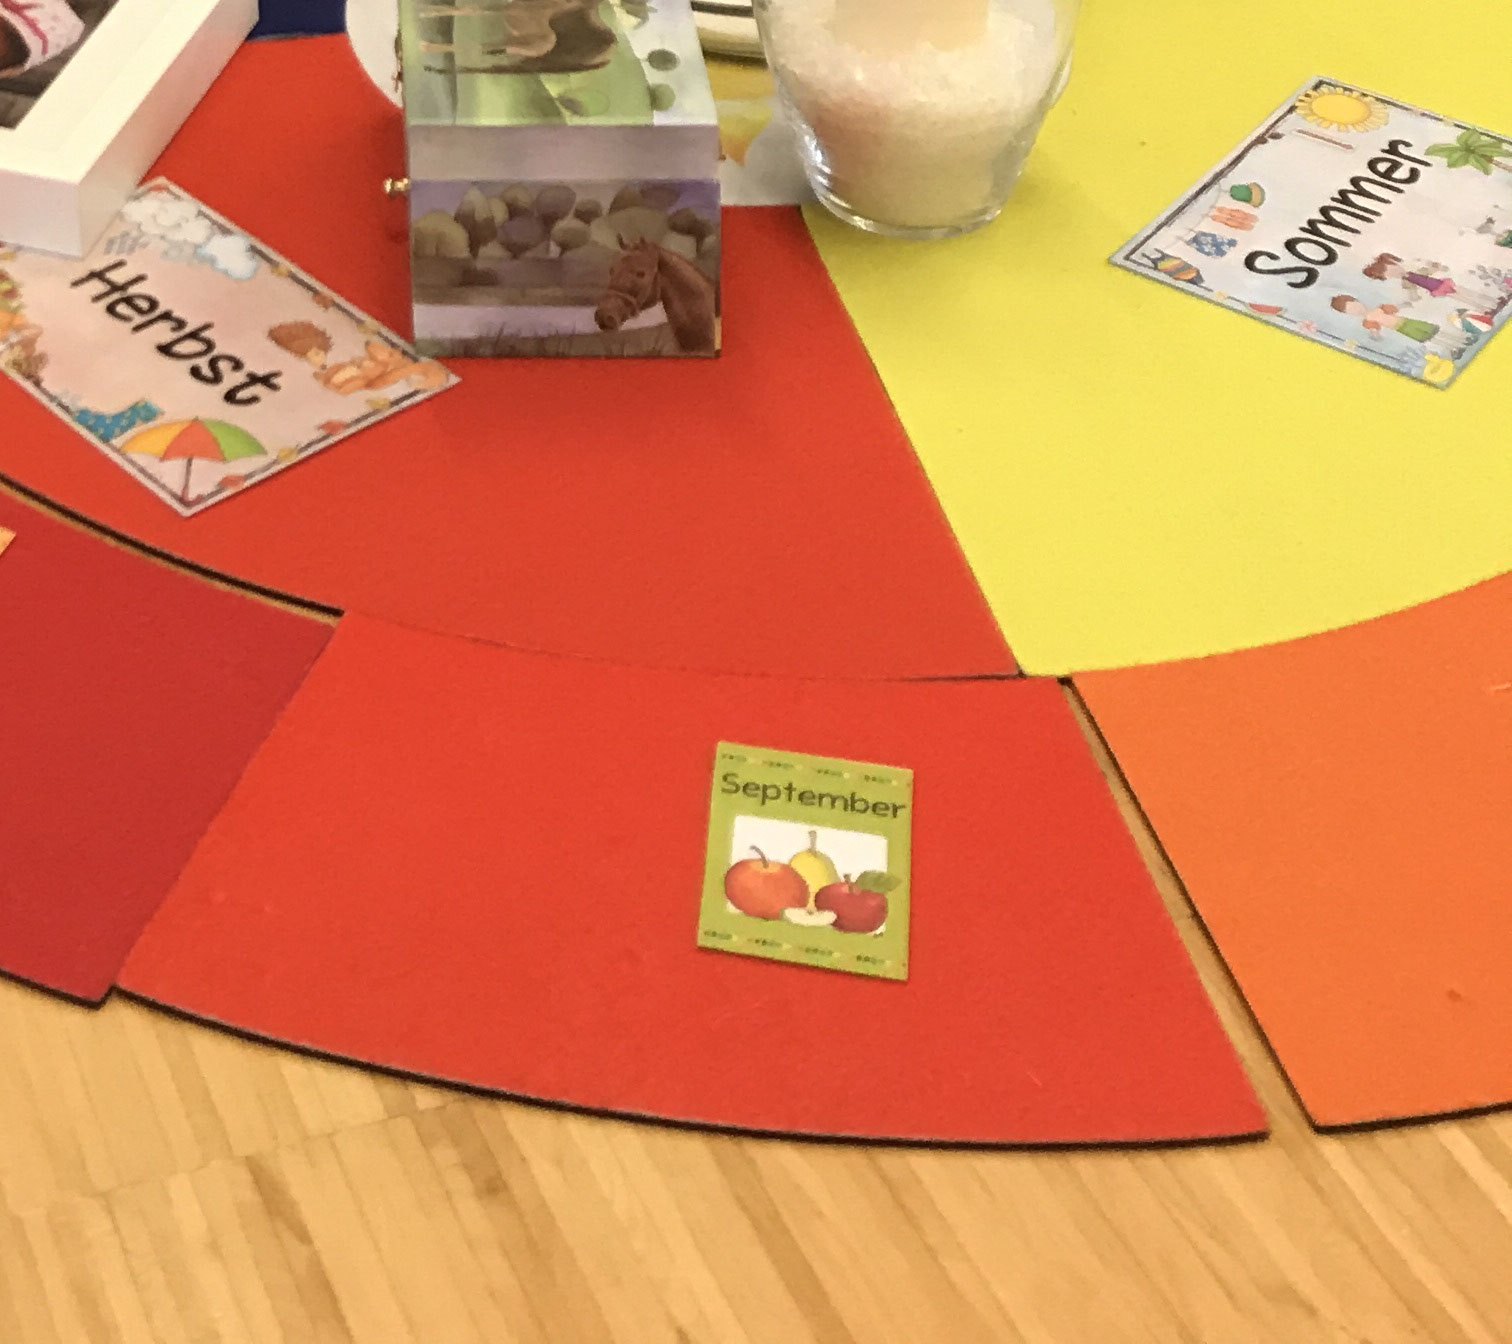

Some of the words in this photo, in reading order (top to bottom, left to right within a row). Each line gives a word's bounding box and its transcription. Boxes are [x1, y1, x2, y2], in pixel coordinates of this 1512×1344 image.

[1243, 138, 1434, 290] Sommer
[69, 258, 283, 408] Herbst
[720, 771, 908, 820] September
